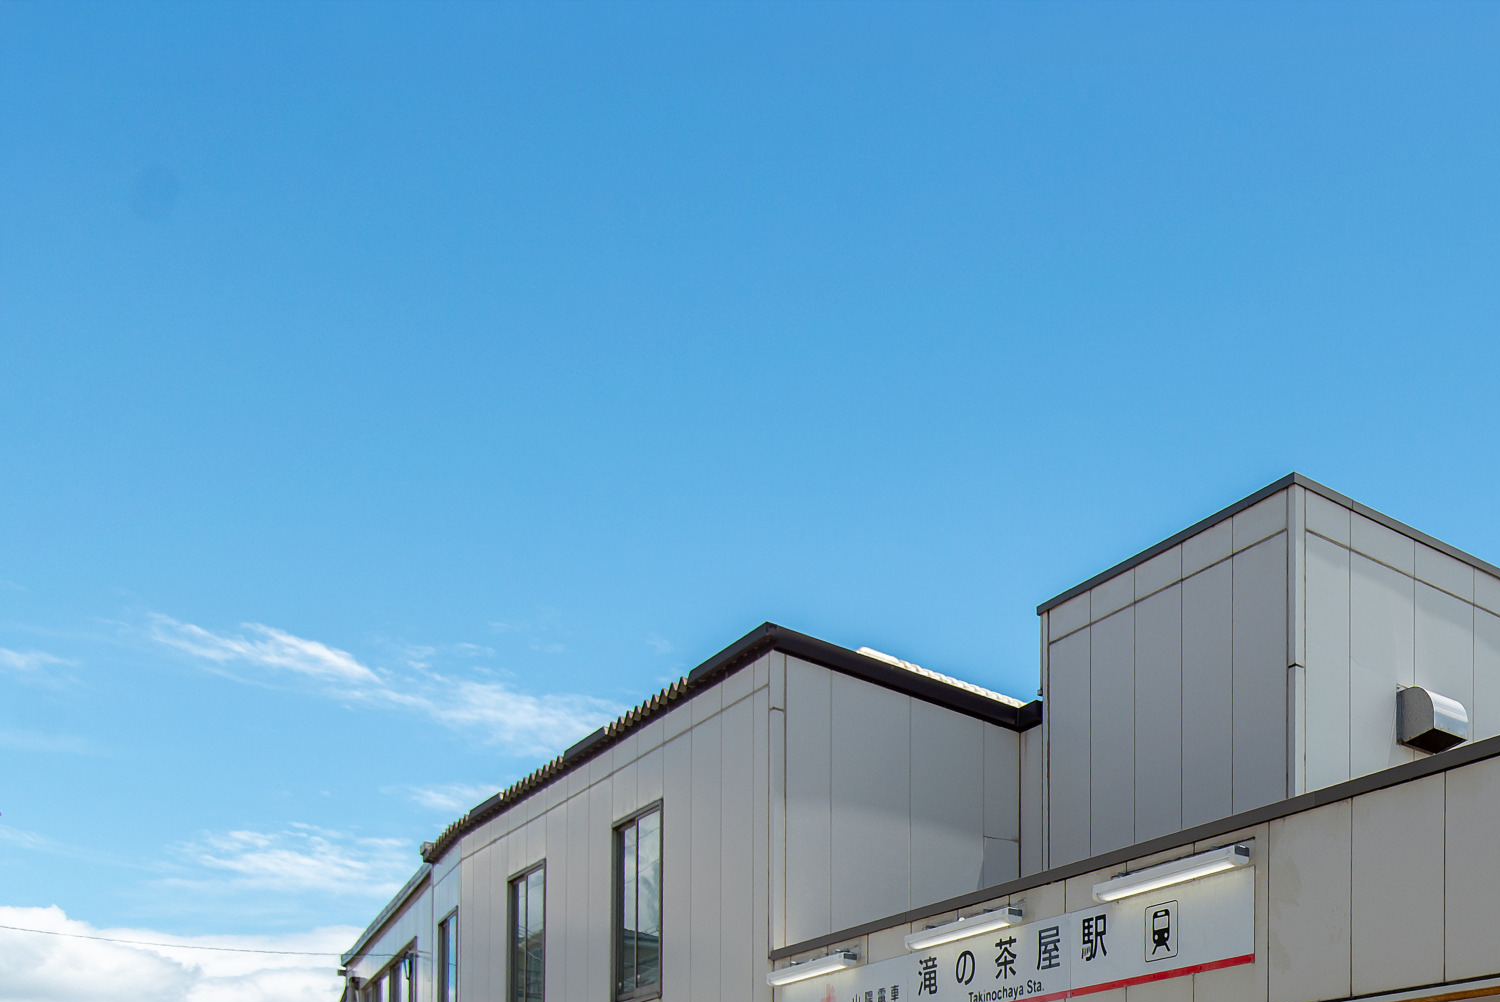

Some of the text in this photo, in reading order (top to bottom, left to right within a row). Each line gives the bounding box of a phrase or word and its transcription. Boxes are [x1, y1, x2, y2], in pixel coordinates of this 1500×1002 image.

[917, 913, 1108, 997] 滝の茶屋駅
[1026, 979, 1045, 994] Sta.
